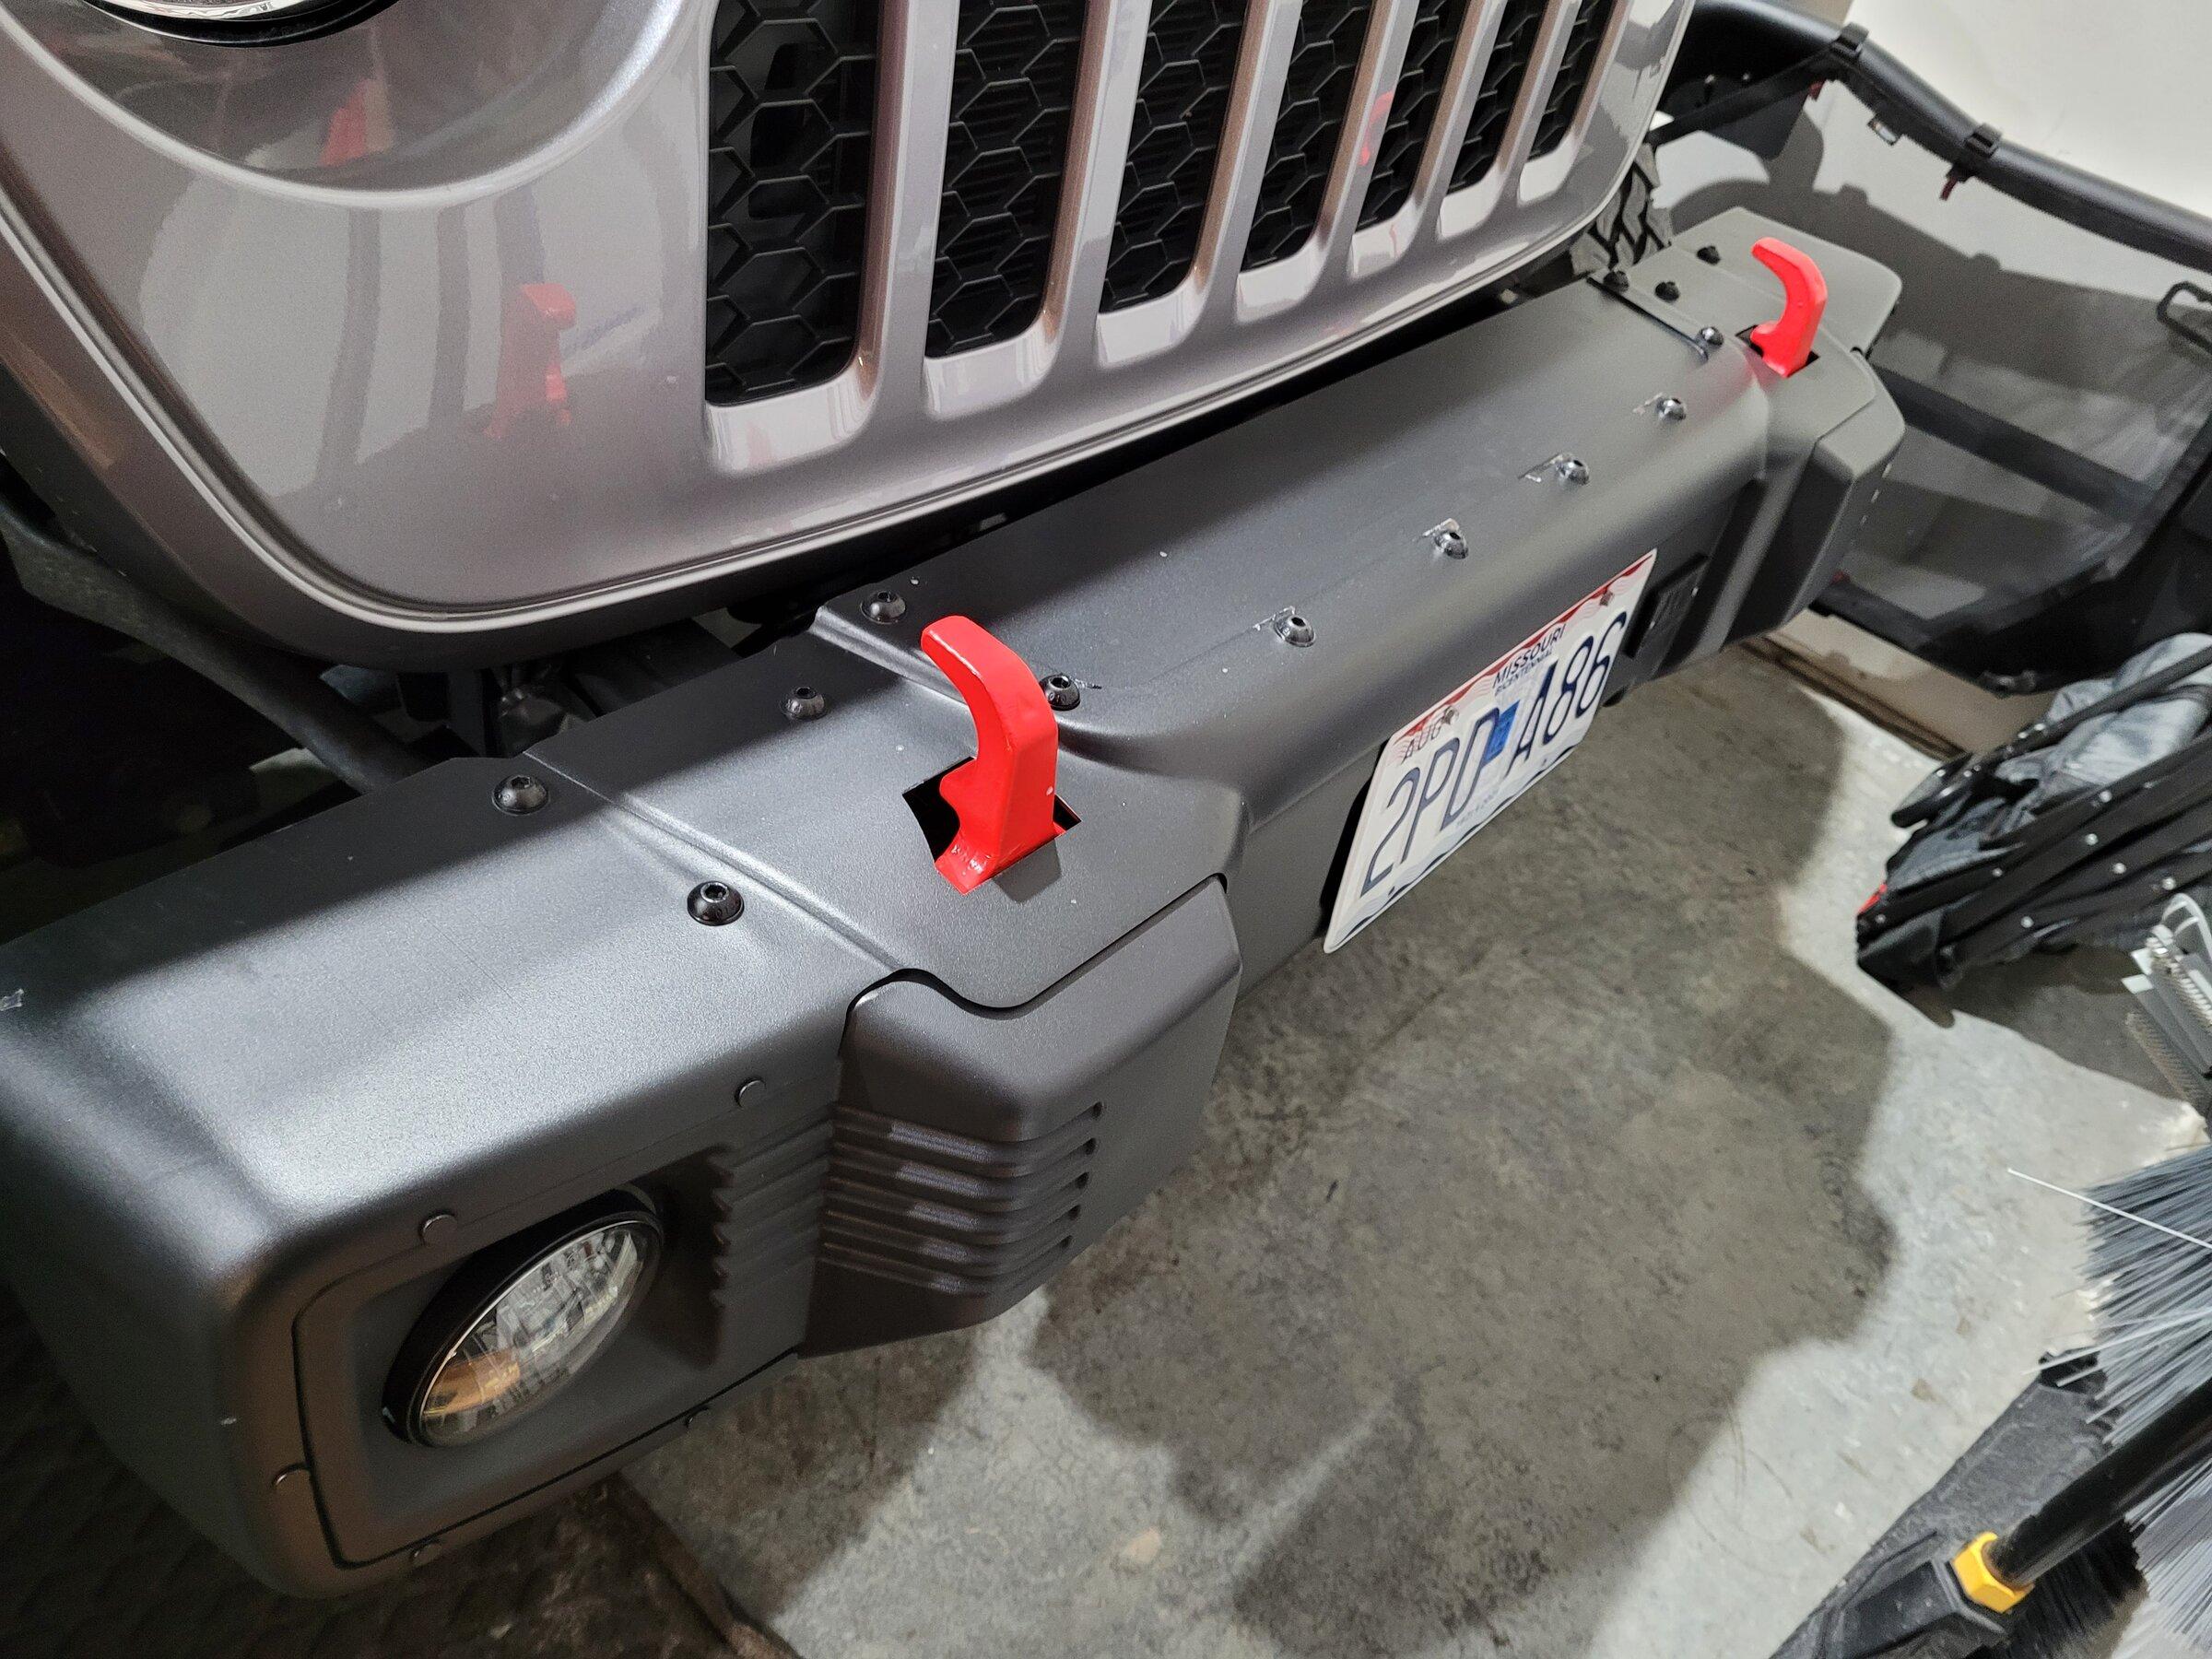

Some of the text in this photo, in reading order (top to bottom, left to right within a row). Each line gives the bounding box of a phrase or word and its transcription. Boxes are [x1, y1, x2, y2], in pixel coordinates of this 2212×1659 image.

[1492, 623, 1566, 688] MISSOURI
[1359, 611, 1627, 899] 2PD A86
[1401, 715, 1444, 765] AUG
